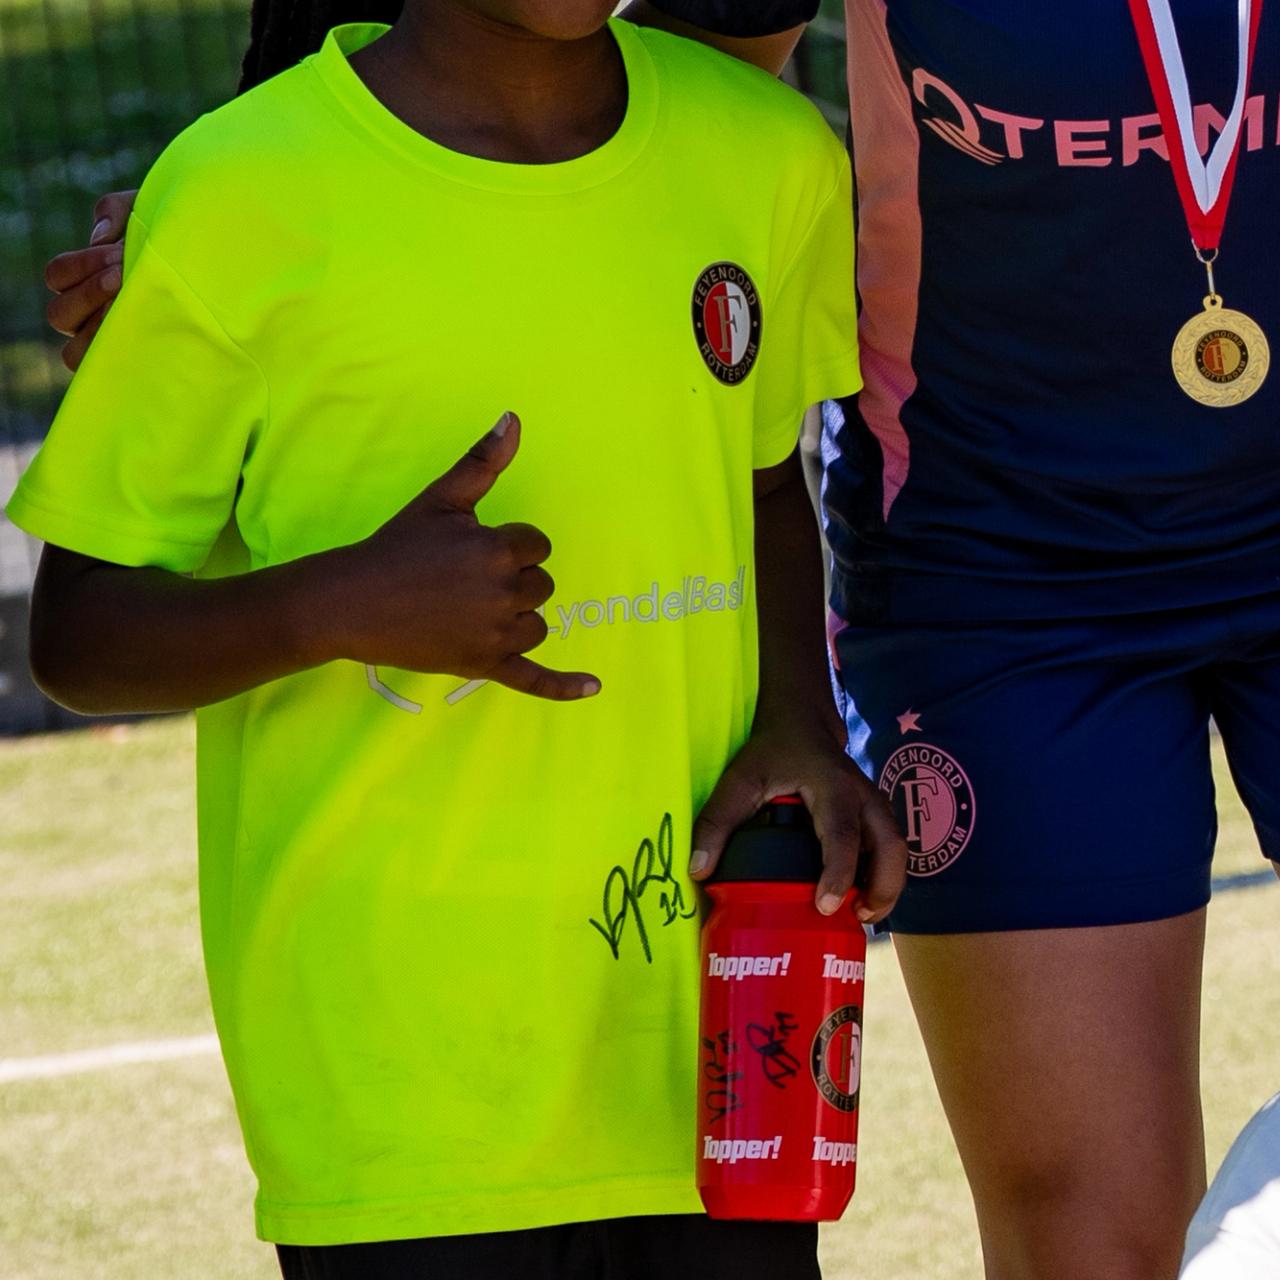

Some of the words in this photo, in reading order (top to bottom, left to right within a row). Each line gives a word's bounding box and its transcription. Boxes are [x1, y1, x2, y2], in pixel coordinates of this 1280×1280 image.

[695, 266, 757, 306] FEYENOORD
[713, 295, 742, 352] F
[1198, 330, 1244, 353] FEYENOORD
[701, 341, 757, 381] ROTTERDAM
[1200, 361, 1246, 382] ROTTERDAM
[882, 748, 963, 793] FEYENOORD
[901, 776, 938, 841] F
[909, 825, 967, 871] TERDAM
[708, 952, 791, 981] Topper!
[703, 1135, 782, 1164] Topper!
